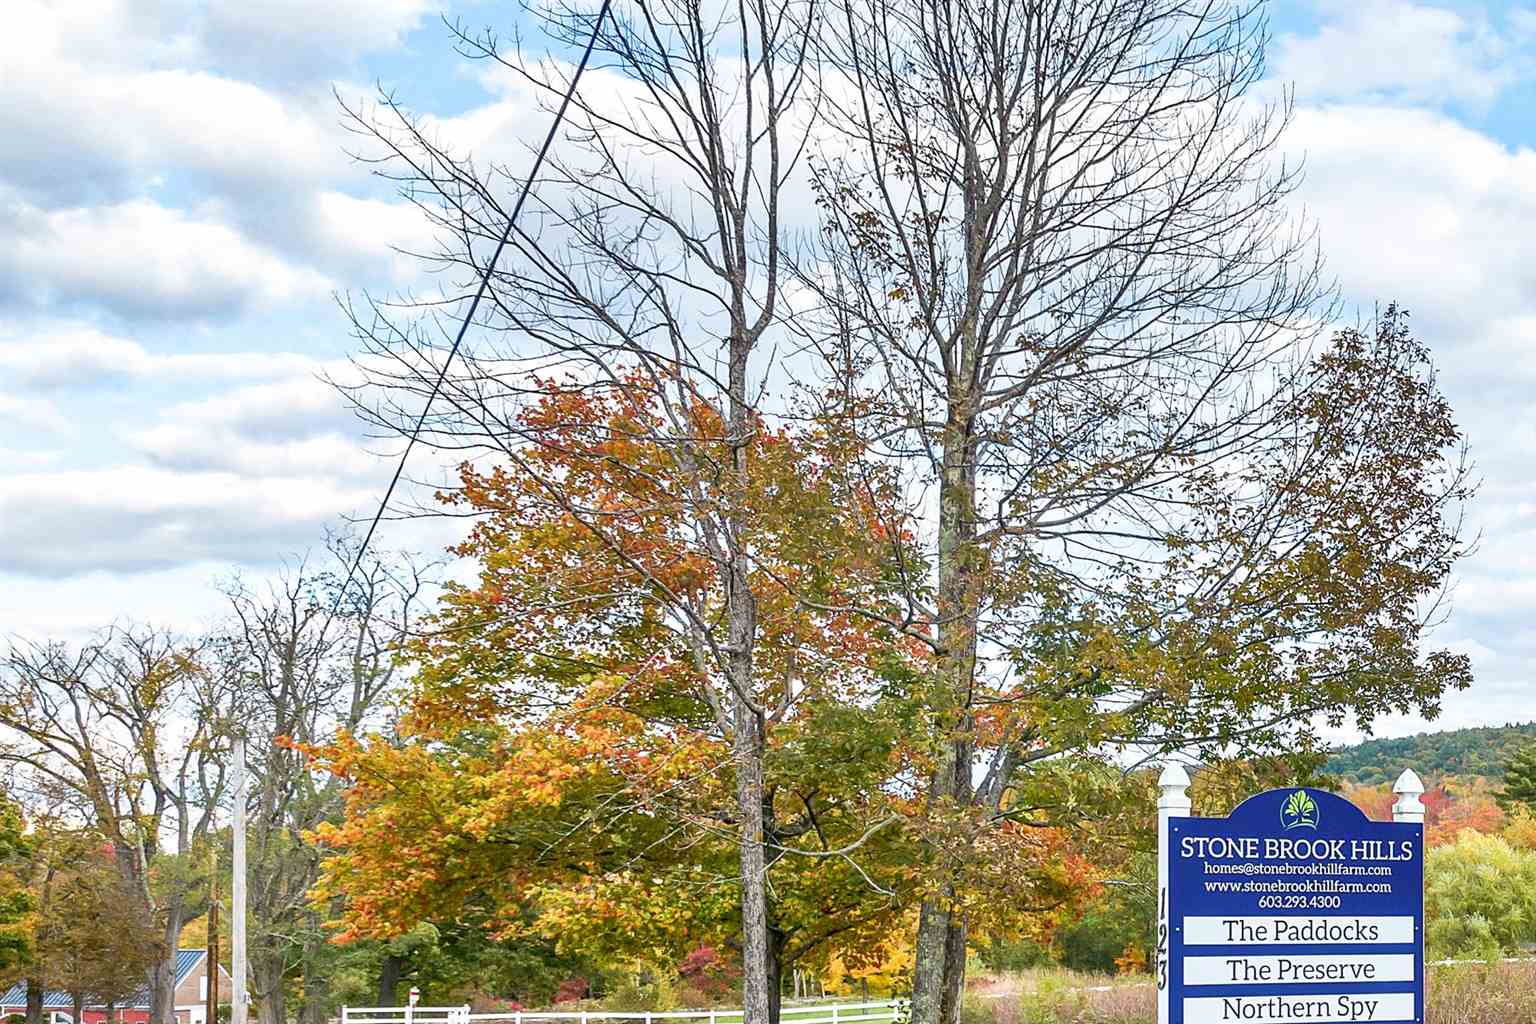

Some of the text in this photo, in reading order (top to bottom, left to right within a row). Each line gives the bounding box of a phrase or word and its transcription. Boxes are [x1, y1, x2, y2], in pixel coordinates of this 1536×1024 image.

[1181, 837, 1413, 861] STONE BROOK HILLS
[1204, 862, 1392, 876] homes@stonebrookhillfarm.com
[1204, 880, 1392, 893] www.stonebrookhillfarm.com
[1258, 896, 1341, 909] 603.293.4300
[1222, 919, 1379, 941] The Paddocks
[1226, 959, 1376, 981] The Preserve
[1222, 996, 1379, 1020] Northern Spy
